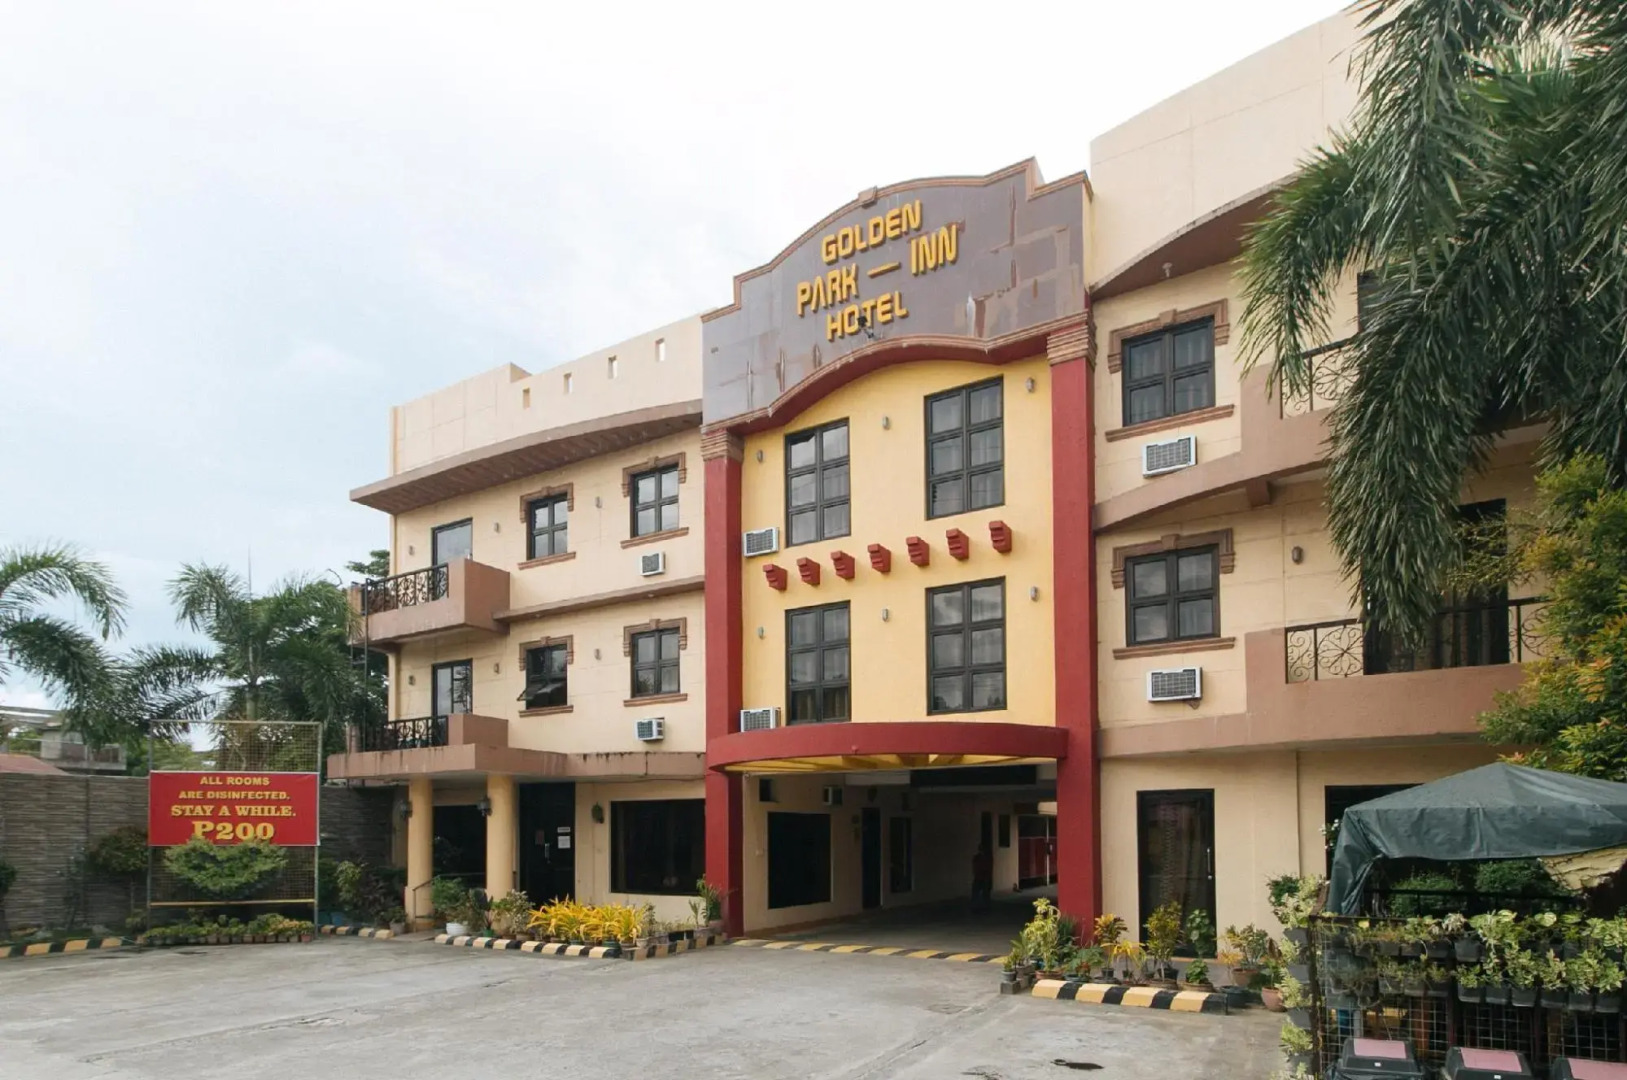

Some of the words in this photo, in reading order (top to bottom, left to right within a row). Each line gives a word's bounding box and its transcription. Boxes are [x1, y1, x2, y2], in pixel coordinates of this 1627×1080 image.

[821, 200, 921, 263] GOLDEN
[797, 263, 858, 316] PARK
[910, 224, 958, 275] INN
[826, 291, 909, 340] HOTEL
[200, 777, 223, 785] ALL
[226, 777, 270, 785] ROOMS
[178, 791, 203, 800] ARE
[207, 791, 291, 800] DISINFECTED.
[171, 805, 214, 817] STAY
[218, 806, 231, 817] A
[235, 806, 296, 817] WHILE.
[192, 821, 275, 841] P200
